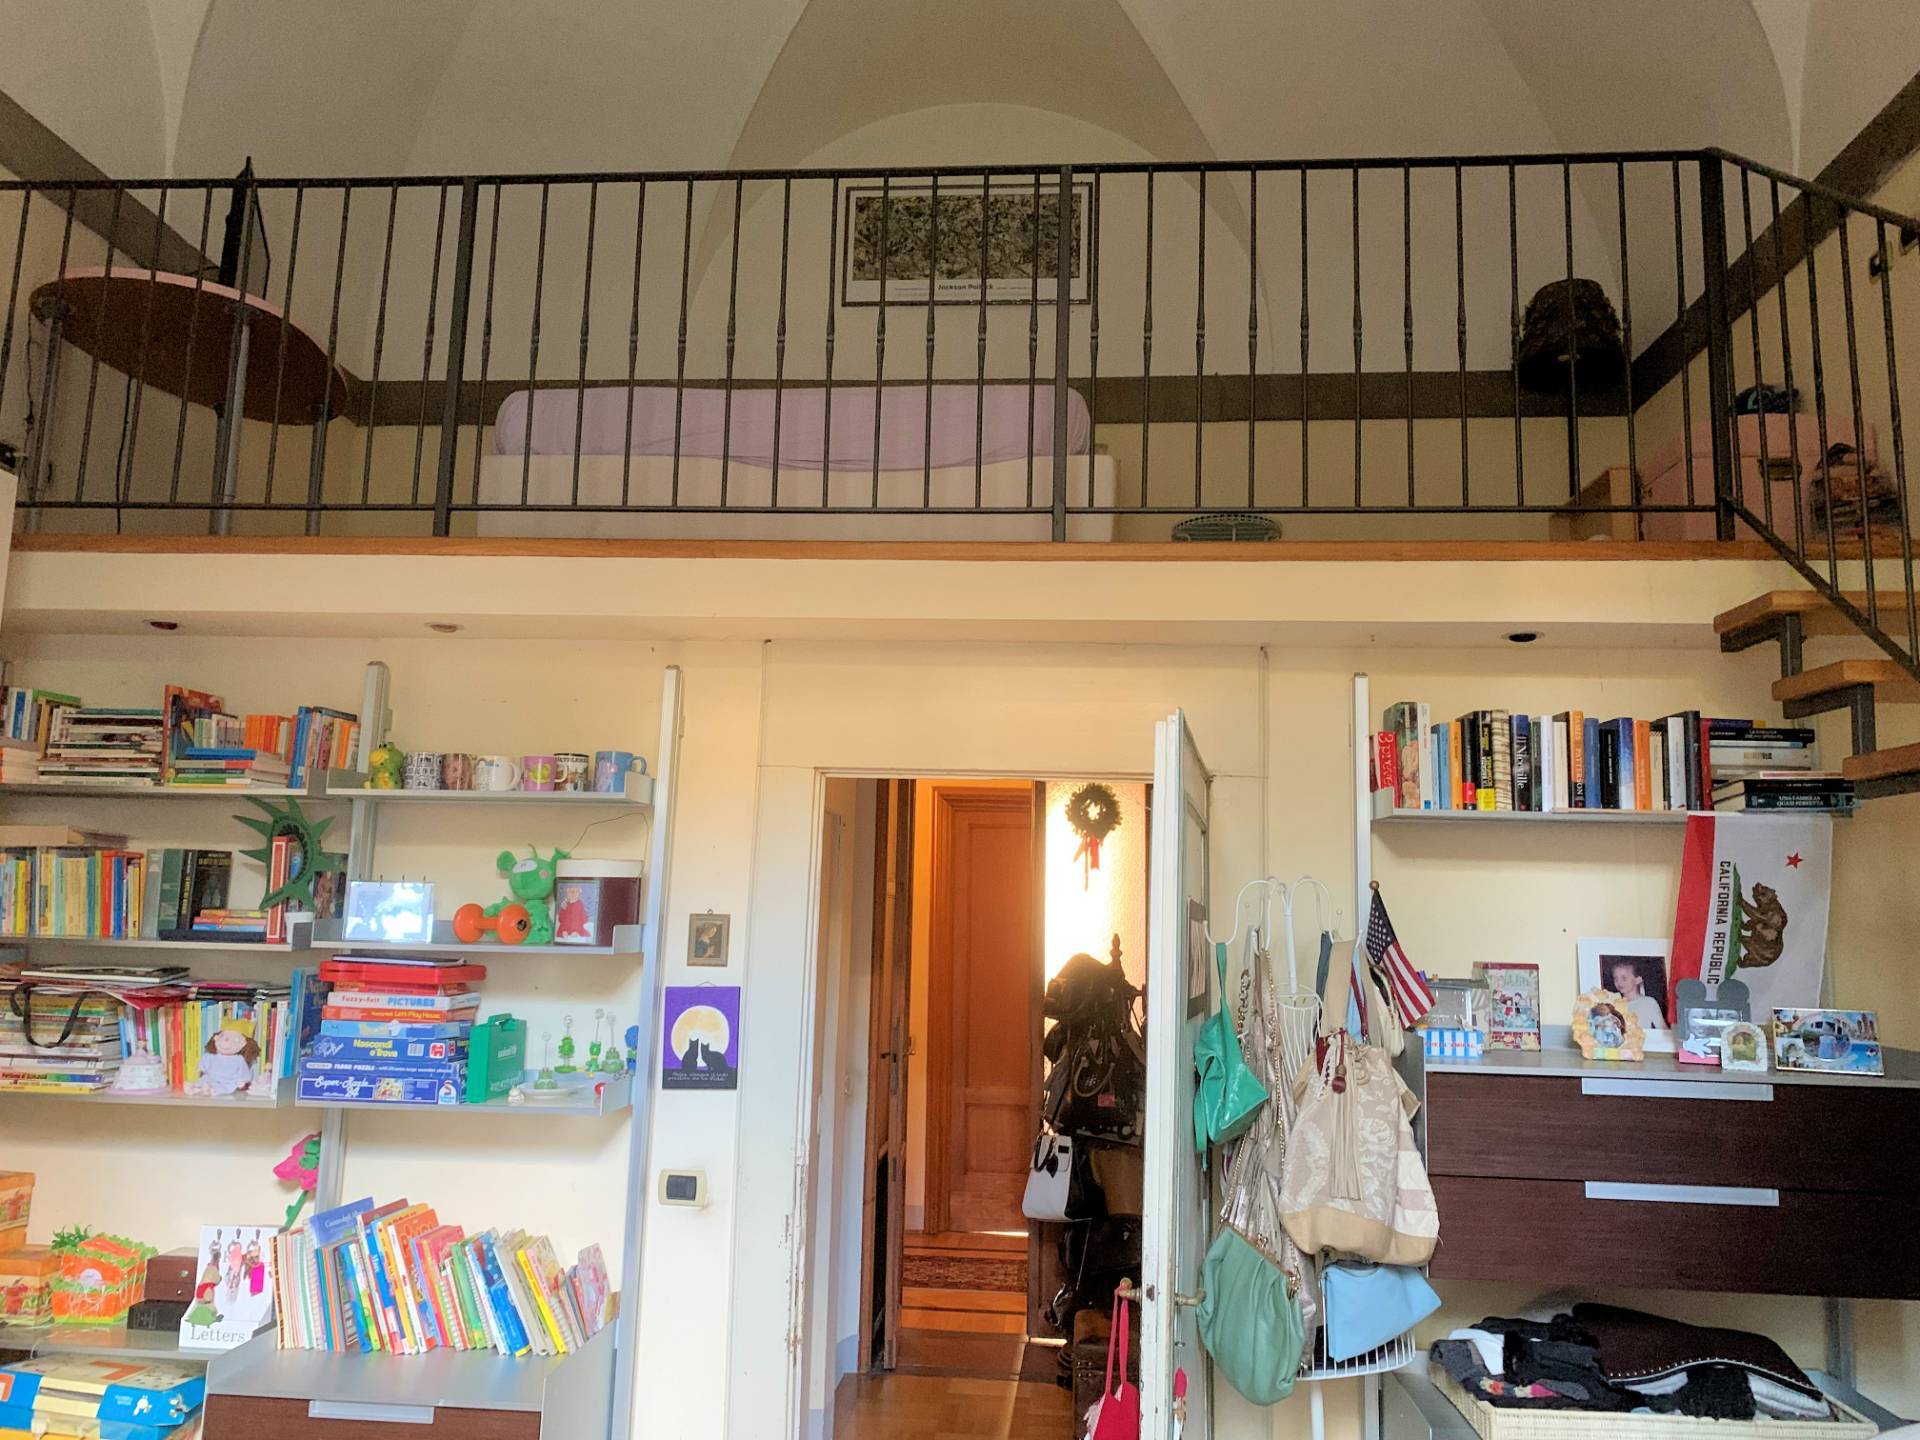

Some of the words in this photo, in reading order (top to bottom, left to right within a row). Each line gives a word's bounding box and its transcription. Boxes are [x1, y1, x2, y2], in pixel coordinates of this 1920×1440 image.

[1516, 745, 1528, 789] Niceville
[1575, 748, 1584, 795] PATTERSON
[1715, 861, 1731, 925] CALIFORNIA
[1707, 932, 1725, 984] REPUBLIC
[388, 997, 436, 1007] PICTURES
[190, 1326, 246, 1343] Letters
